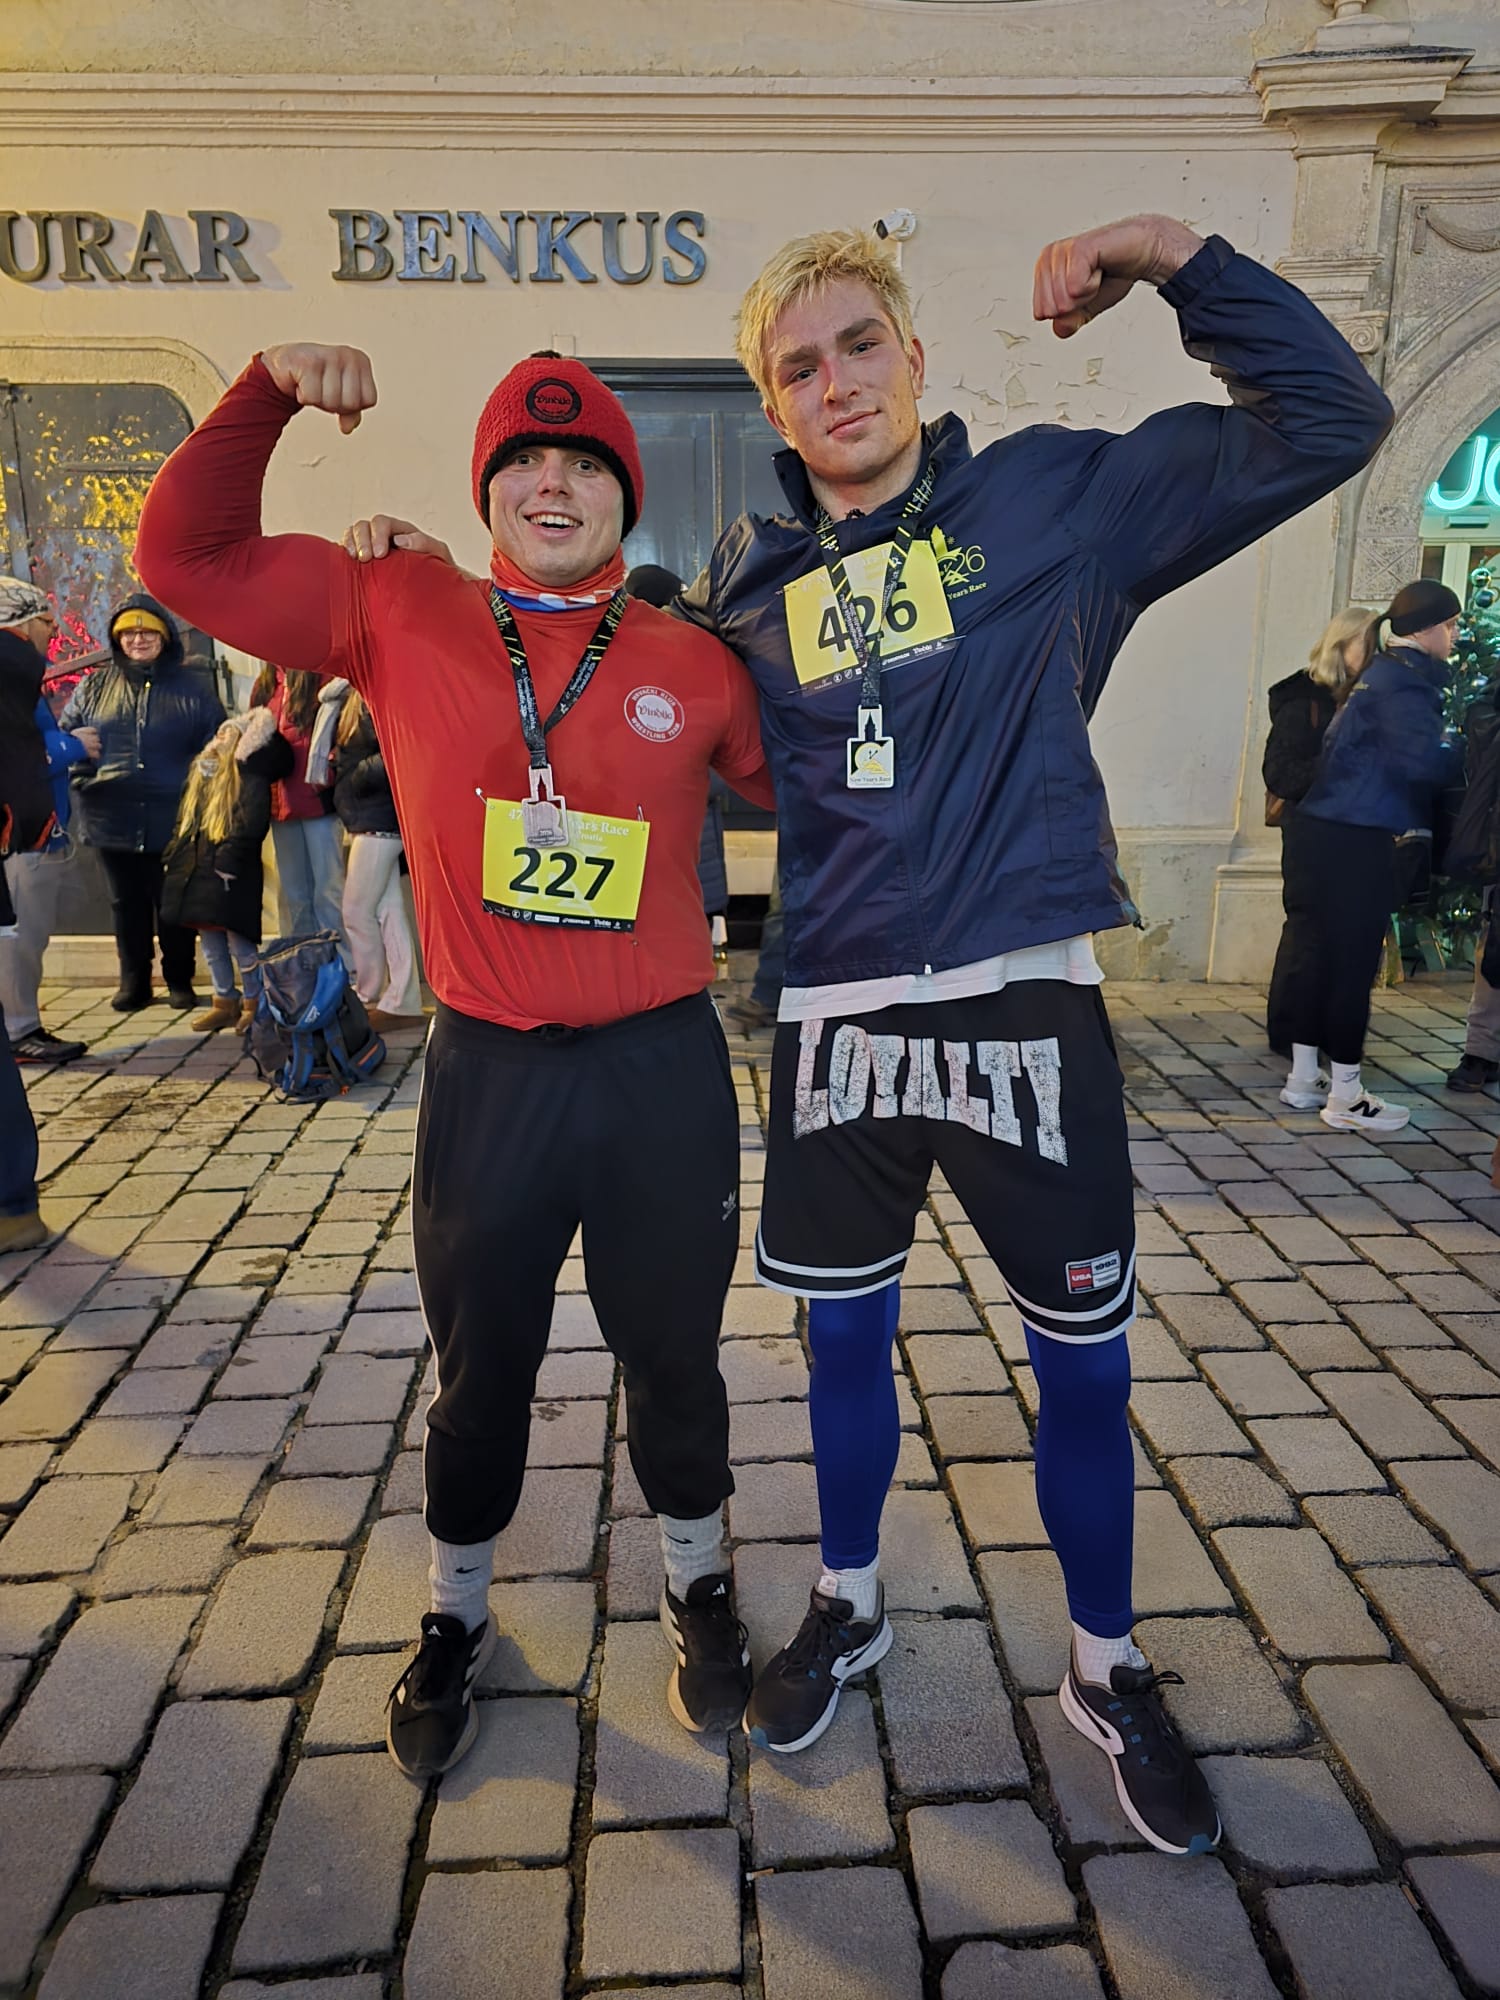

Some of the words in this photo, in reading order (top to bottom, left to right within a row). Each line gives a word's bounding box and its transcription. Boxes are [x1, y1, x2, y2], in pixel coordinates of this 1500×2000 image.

[0, 210, 260, 282] URAR
[328, 209, 707, 284] BENKUS
[969, 582, 987, 593] Race
[818, 581, 917, 653] 426
[601, 822, 629, 836] Race
[509, 847, 615, 901] 227
[792, 1018, 1069, 1167] LOYALTY
[1071, 1273, 1092, 1282] USA
